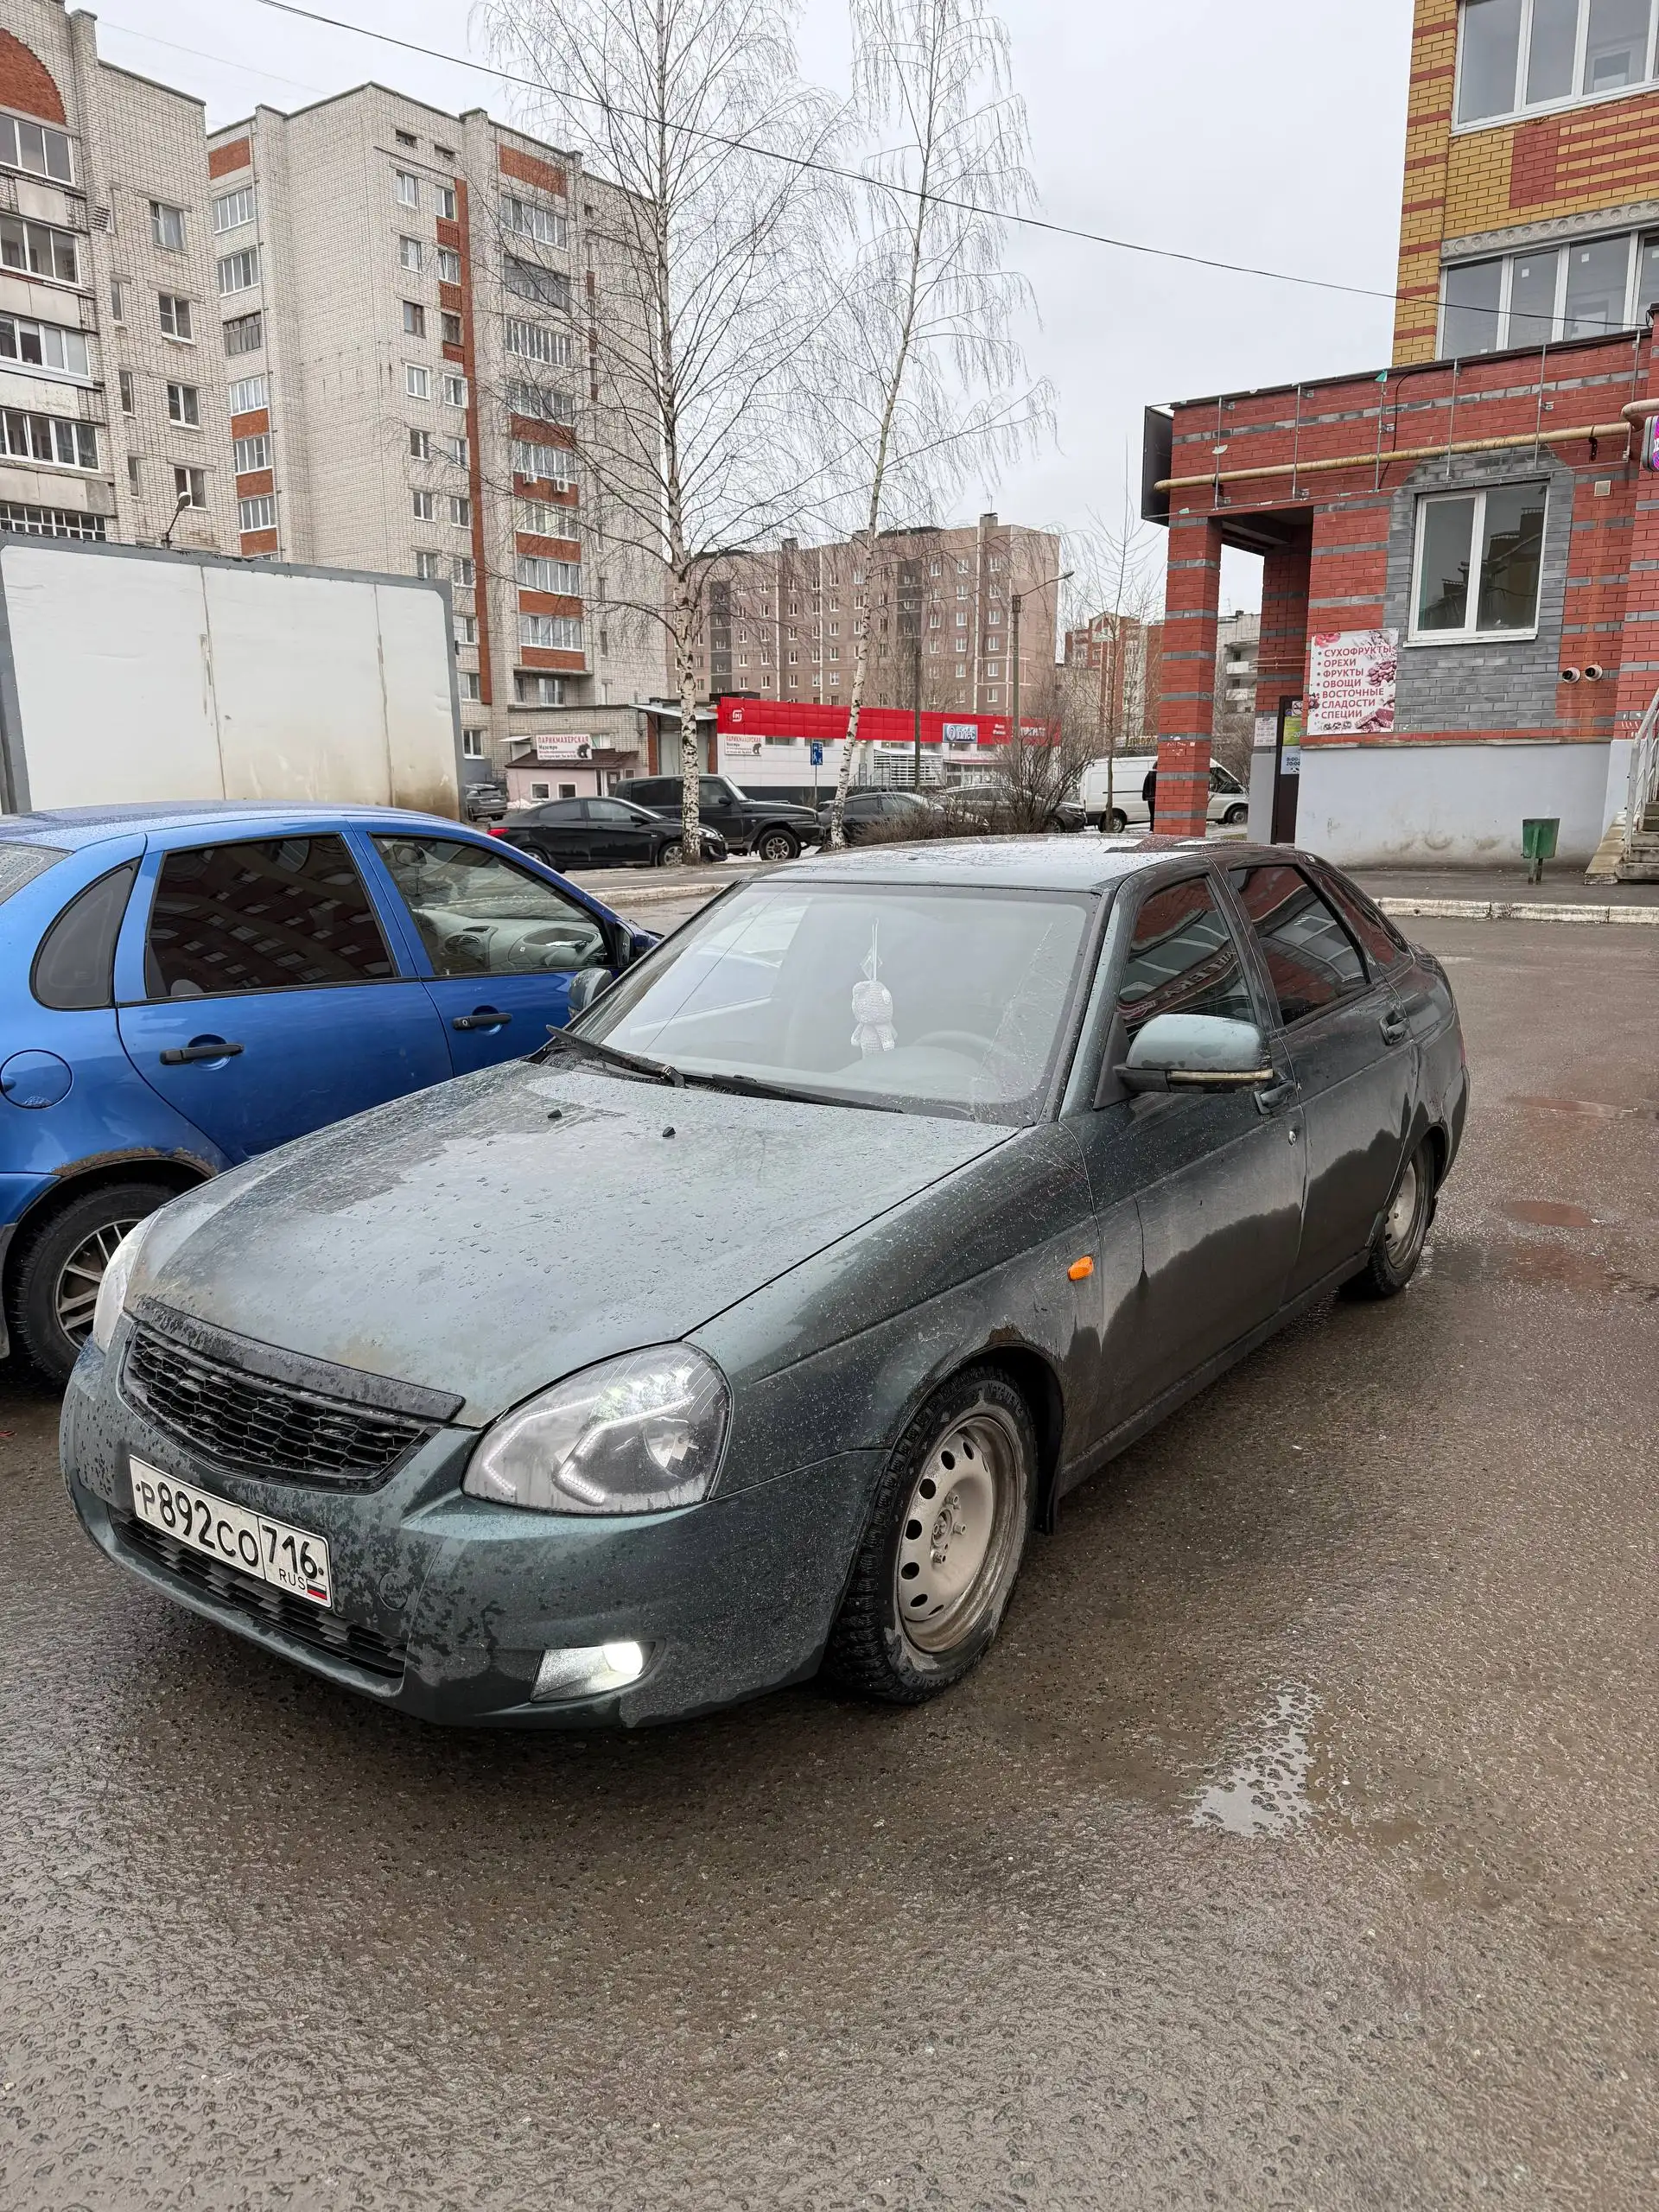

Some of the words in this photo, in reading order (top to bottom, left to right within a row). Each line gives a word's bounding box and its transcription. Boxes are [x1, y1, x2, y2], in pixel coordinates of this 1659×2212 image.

[1324, 645, 1391, 658] СУХОФРУКТЫ
[1324, 658, 1357, 668] ОРЕХИ
[1323, 668, 1363, 677] ФРУКТЫ
[1322, 678, 1362, 689] ОВОЩИ
[1322, 688, 1384, 699] ВОСТОЧНЫЕ
[1321, 699, 1376, 709] СЛАДОСТИ
[1321, 709, 1363, 720] СПЕЦИИ
[537, 735, 589, 744] ПАРИКМАХЕРСКАЯ
[278, 1567, 307, 1591] RUS
